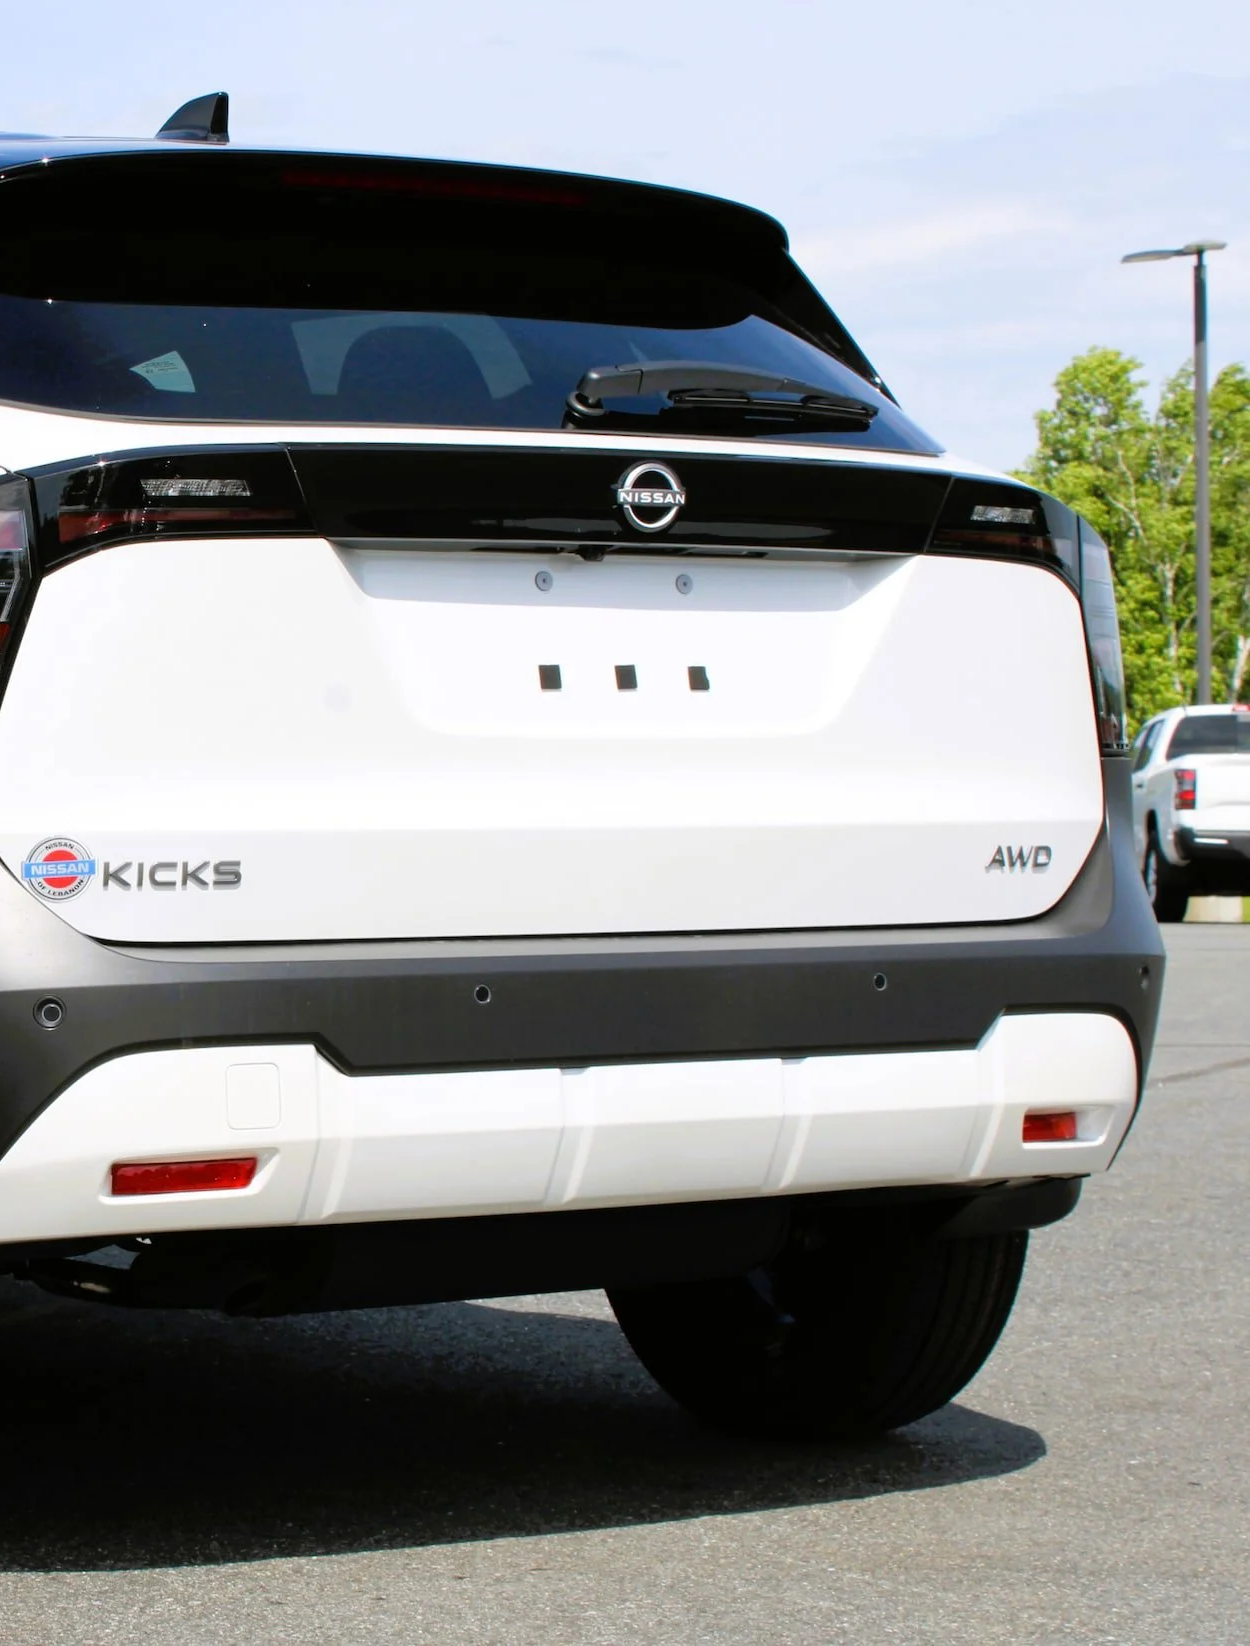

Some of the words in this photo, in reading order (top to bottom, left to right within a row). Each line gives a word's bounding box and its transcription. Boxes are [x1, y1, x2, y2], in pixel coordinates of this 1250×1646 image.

[619, 492, 685, 504] NISSAN
[45, 841, 74, 850] NISSAN
[985, 845, 1052, 871] AWD
[30, 862, 90, 876] NISSAN
[102, 860, 242, 889] KICKS
[37, 880, 47, 891] OF
[47, 879, 84, 897] LEBANON
